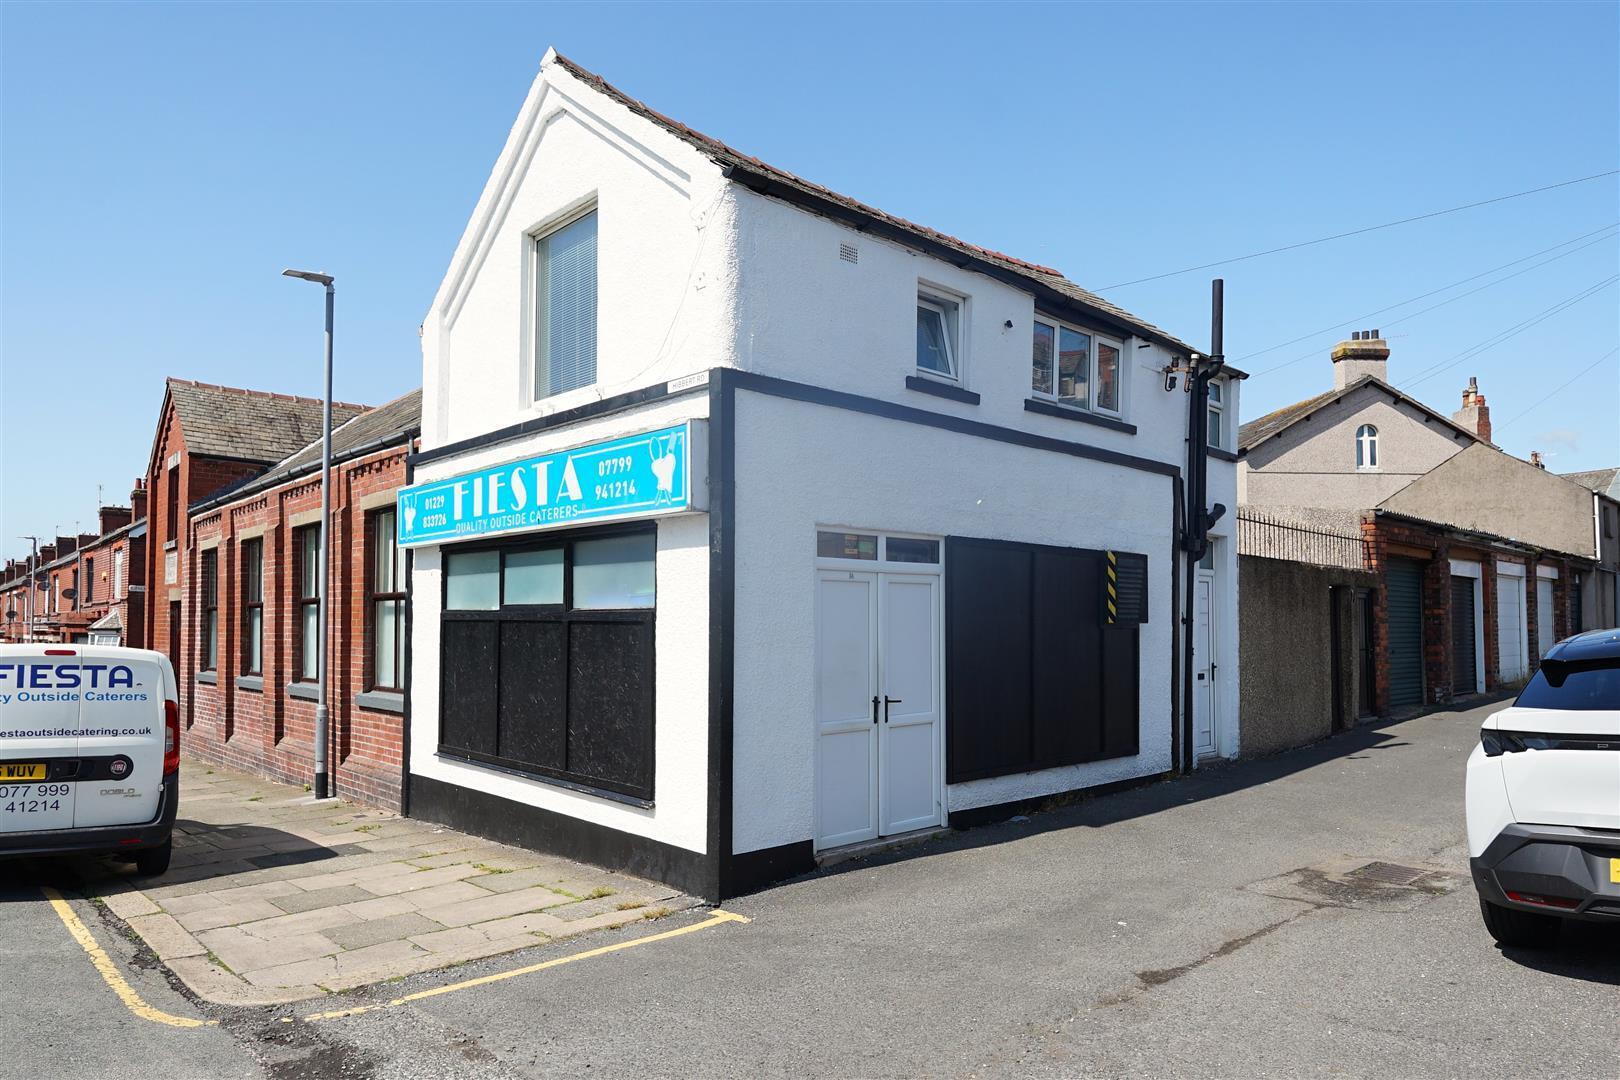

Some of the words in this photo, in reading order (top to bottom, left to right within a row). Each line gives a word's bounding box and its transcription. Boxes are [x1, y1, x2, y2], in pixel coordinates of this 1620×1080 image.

[672, 377, 695, 389] HIBBERT
[598, 456, 632, 477] 07799
[453, 455, 583, 521] FIESTA
[595, 479, 636, 500] 941214
[425, 495, 445, 510] 01229
[456, 519, 488, 534] QUALITY
[490, 513, 526, 528] OUTSIDE
[529, 504, 578, 522] CATERERS
[17, 691, 79, 702] Outside
[85, 691, 148, 702] Caterers
[7, 765, 36, 777] WUV
[38, 784, 69, 796] 999
[5, 800, 60, 813] 41214
